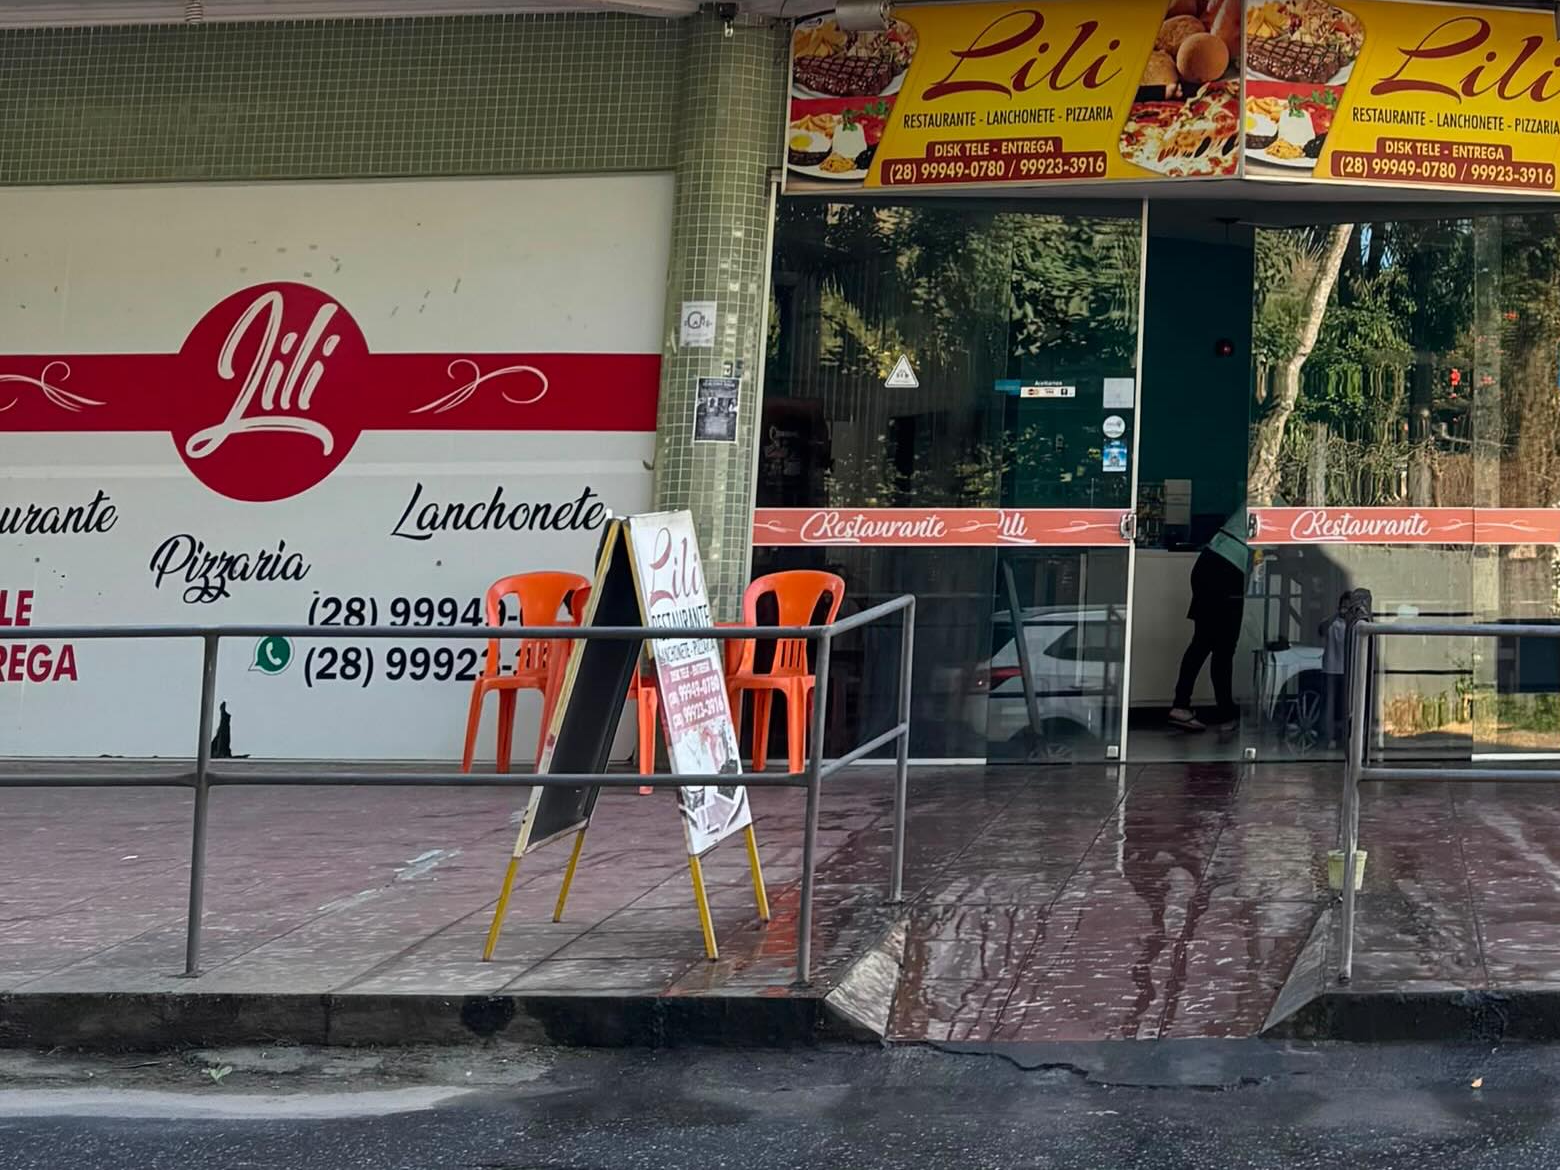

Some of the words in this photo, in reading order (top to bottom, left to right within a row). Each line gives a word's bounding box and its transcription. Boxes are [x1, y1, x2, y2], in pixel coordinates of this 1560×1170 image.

[922, 9, 1123, 102] Lili
[904, 110, 977, 130] RESTAURANTE
[986, 107, 1056, 127] LANCHONETE
[1065, 104, 1114, 123] PIZZARIA
[1352, 106, 1427, 127] RESTAURANTE
[1436, 112, 1505, 132] LANCHONETE
[1514, 117, 1560, 136] PIZZARIA
[934, 142, 961, 158] DISK
[963, 141, 990, 157] TELE
[1000, 138, 1054, 155] ENTREGA
[1384, 140, 1413, 156] DISK
[1416, 142, 1441, 158] TELE
[1451, 144, 1505, 161] ENTREGA
[889, 161, 917, 185] (28)
[920, 158, 1005, 180] 99949-0780
[1019, 155, 1105, 176] 99923-3916
[1339, 156, 1369, 177] (28)
[1371, 158, 1457, 180] 99949-0780
[1470, 163, 1553, 185] 99923-3916
[185, 290, 342, 459] Lili
[390, 482, 610, 540] Lanchonete
[800, 510, 947, 543] Restaurante
[1290, 510, 1432, 542] Restaurante
[150, 534, 312, 604] Pizzaria
[650, 527, 700, 608] Lili
[304, 646, 374, 687] (28)
